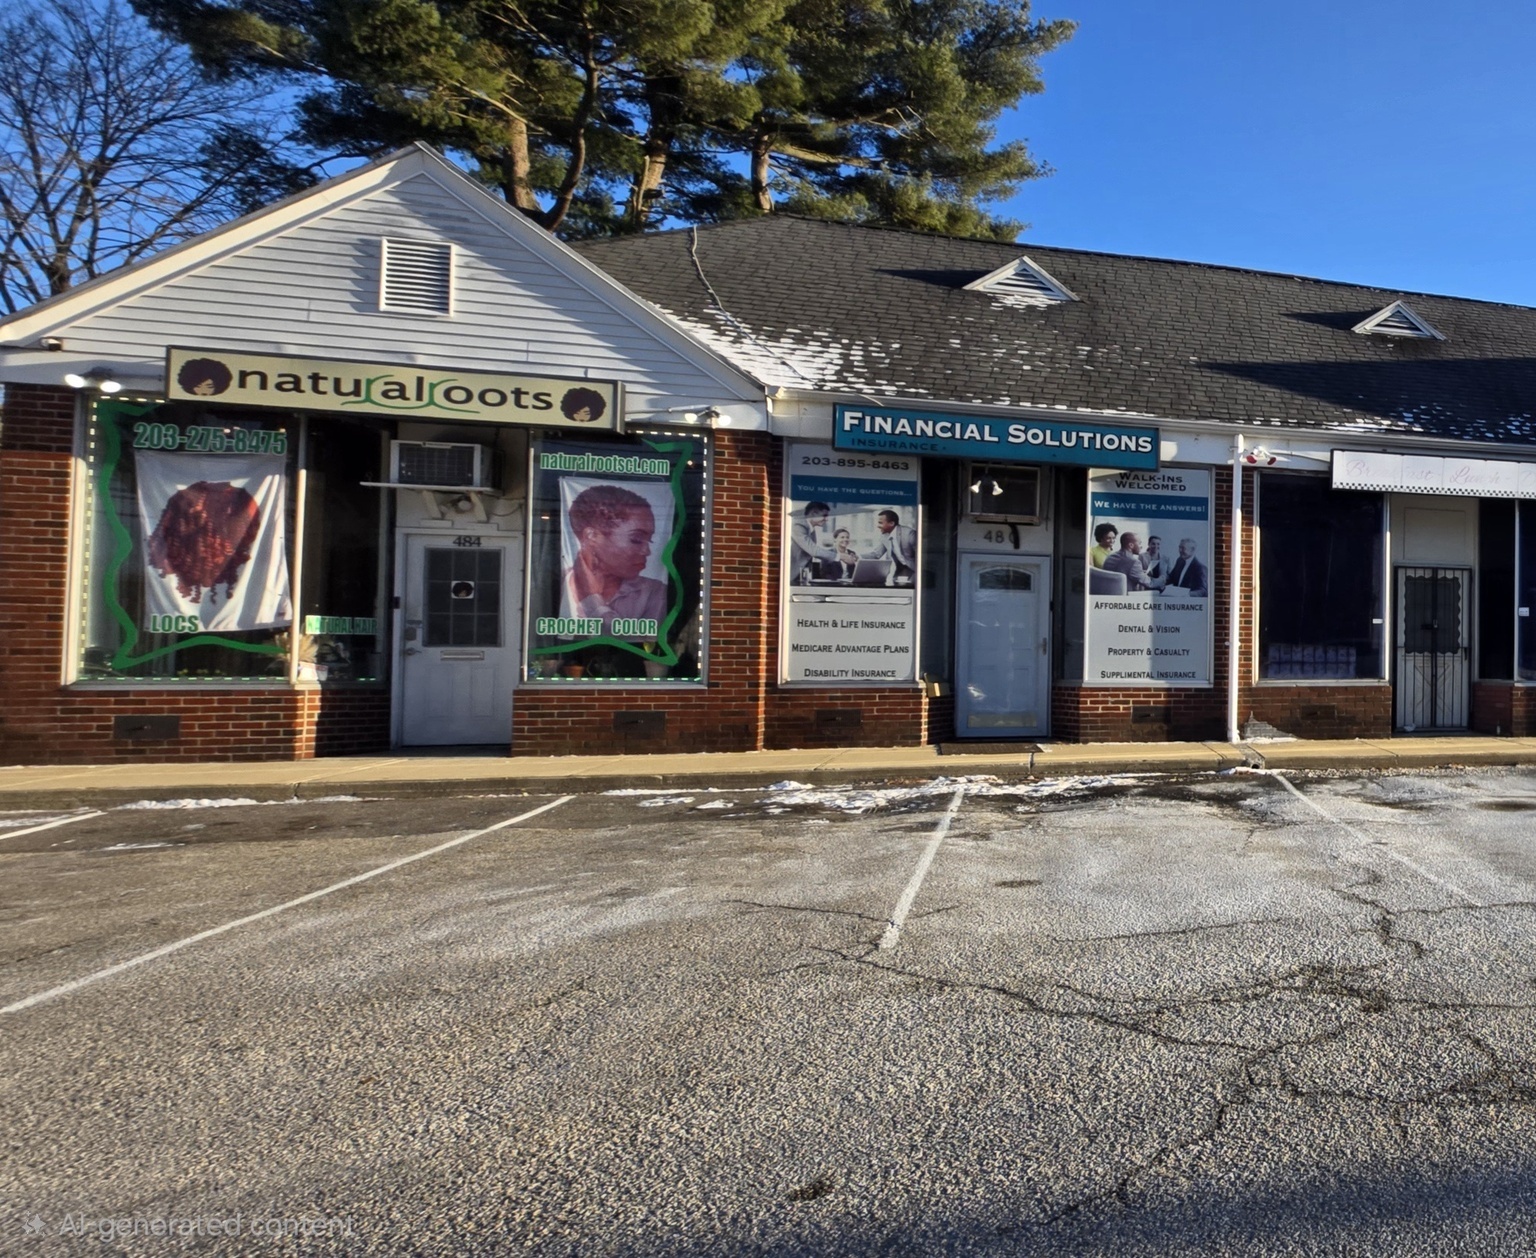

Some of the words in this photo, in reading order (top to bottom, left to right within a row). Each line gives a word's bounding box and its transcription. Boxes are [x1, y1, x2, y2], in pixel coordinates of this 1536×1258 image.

[842, 410, 999, 443] FINANCIAL
[1007, 423, 1153, 454] SOLUTIONS
[133, 421, 288, 456] 203-275-8475
[850, 436, 938, 452] INSURANCE
[540, 452, 671, 476] naturalrootsct.com
[801, 455, 910, 471] 203-895-8463
[1119, 472, 1183, 484] WALK-INS
[1450, 465, 1500, 485] Lunh
[797, 484, 815, 492] YOU
[1115, 481, 1187, 492] WELCOMED
[1094, 500, 1110, 509] WE
[1113, 502, 1137, 510] HAVE
[1140, 503, 1158, 511] THE
[452, 535, 482, 548] 484
[1094, 601, 1141, 611] AFFORDABLE
[1143, 602, 1162, 611] CARE
[1164, 603, 1204, 612] INSURANCE
[151, 613, 200, 634] LOCS
[306, 614, 353, 635] NATURAL
[354, 616, 378, 635] HAIR
[536, 616, 604, 636] CROCHET
[611, 618, 658, 637] COLOR
[797, 619, 829, 628] HEALTH
[831, 619, 838, 628] &
[840, 620, 859, 629] LIFE
[861, 620, 906, 629] INSURANCE
[1118, 624, 1146, 633] DENTAL
[1147, 625, 1154, 633] &
[1155, 625, 1181, 634] VISION
[791, 643, 833, 653] MEDICARE
[835, 644, 882, 654] ADVANTAGE
[884, 644, 910, 654] PLANS
[1107, 647, 1144, 656] PROPERTY
[1146, 648, 1152, 656] &
[1154, 648, 1191, 656] CASUALTY
[804, 668, 850, 678] DISABILITY
[851, 669, 897, 678] INSURANCE
[1100, 670, 1155, 679] SUPPLIMENTAL
[1157, 670, 1197, 679] INSURANCE
